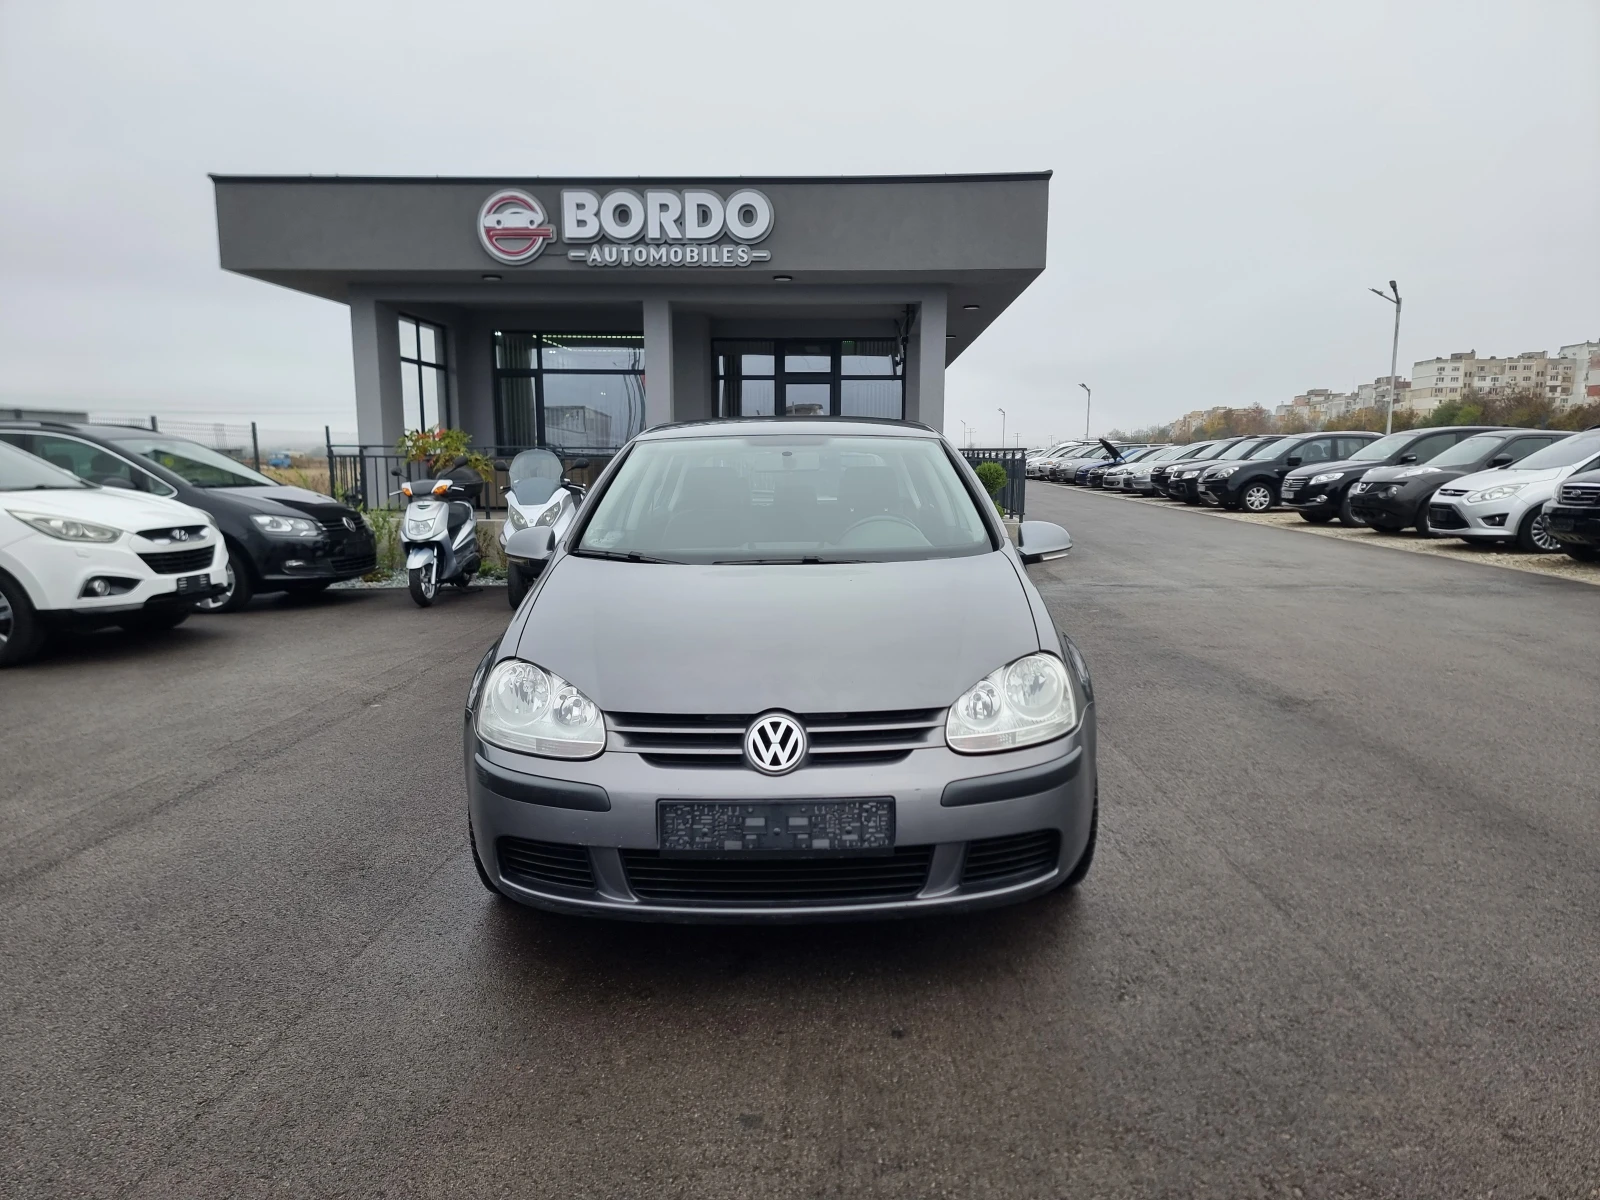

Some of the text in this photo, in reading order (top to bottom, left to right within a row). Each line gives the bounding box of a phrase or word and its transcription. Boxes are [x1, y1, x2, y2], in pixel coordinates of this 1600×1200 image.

[562, 191, 771, 240] BORDO
[588, 246, 749, 263] AUTOMOBILES
[748, 717, 803, 771] VW
